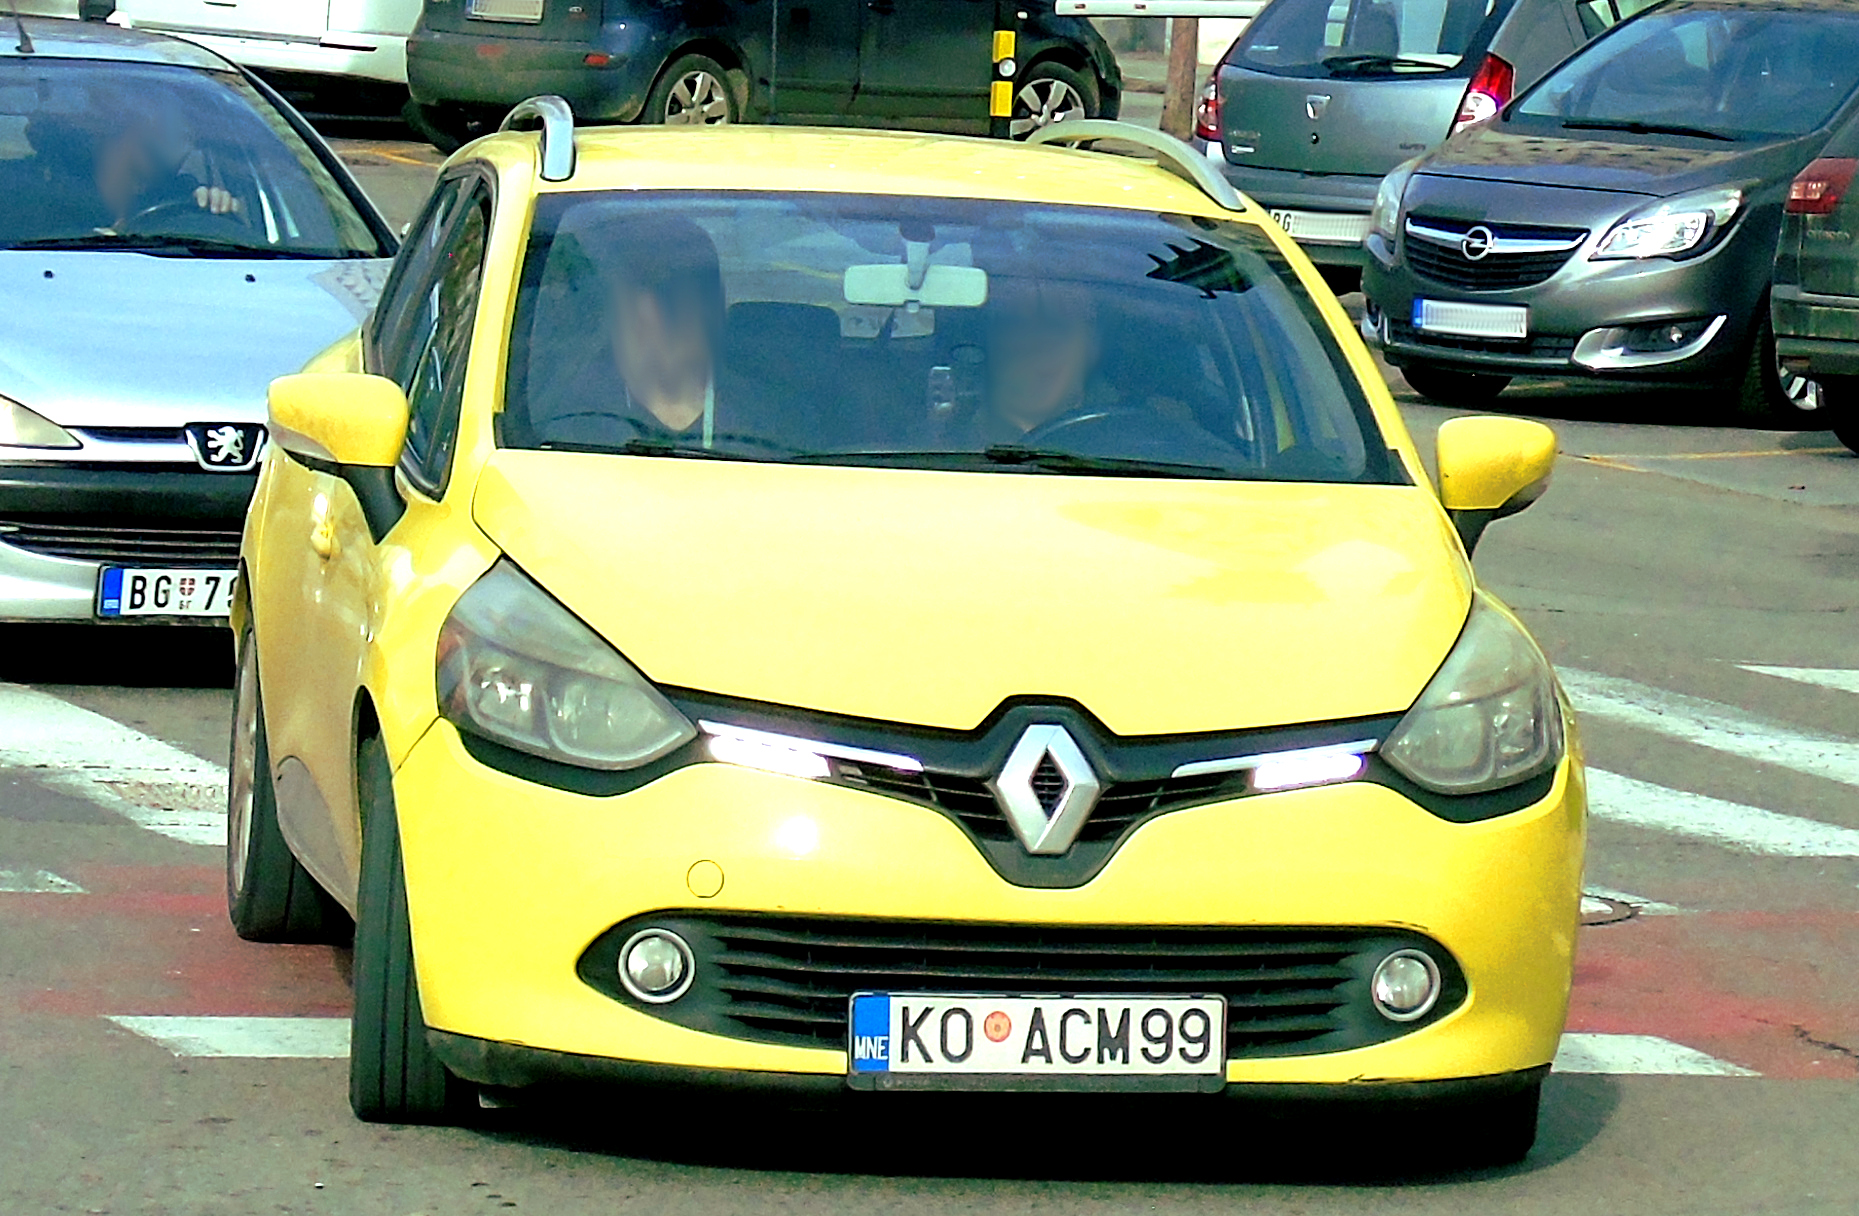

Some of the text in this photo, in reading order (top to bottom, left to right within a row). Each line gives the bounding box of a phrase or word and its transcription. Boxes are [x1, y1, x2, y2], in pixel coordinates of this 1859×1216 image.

[129, 575, 172, 609] BG
[854, 1035, 889, 1060] MNE
[901, 1006, 1212, 1065] KO ACM99
